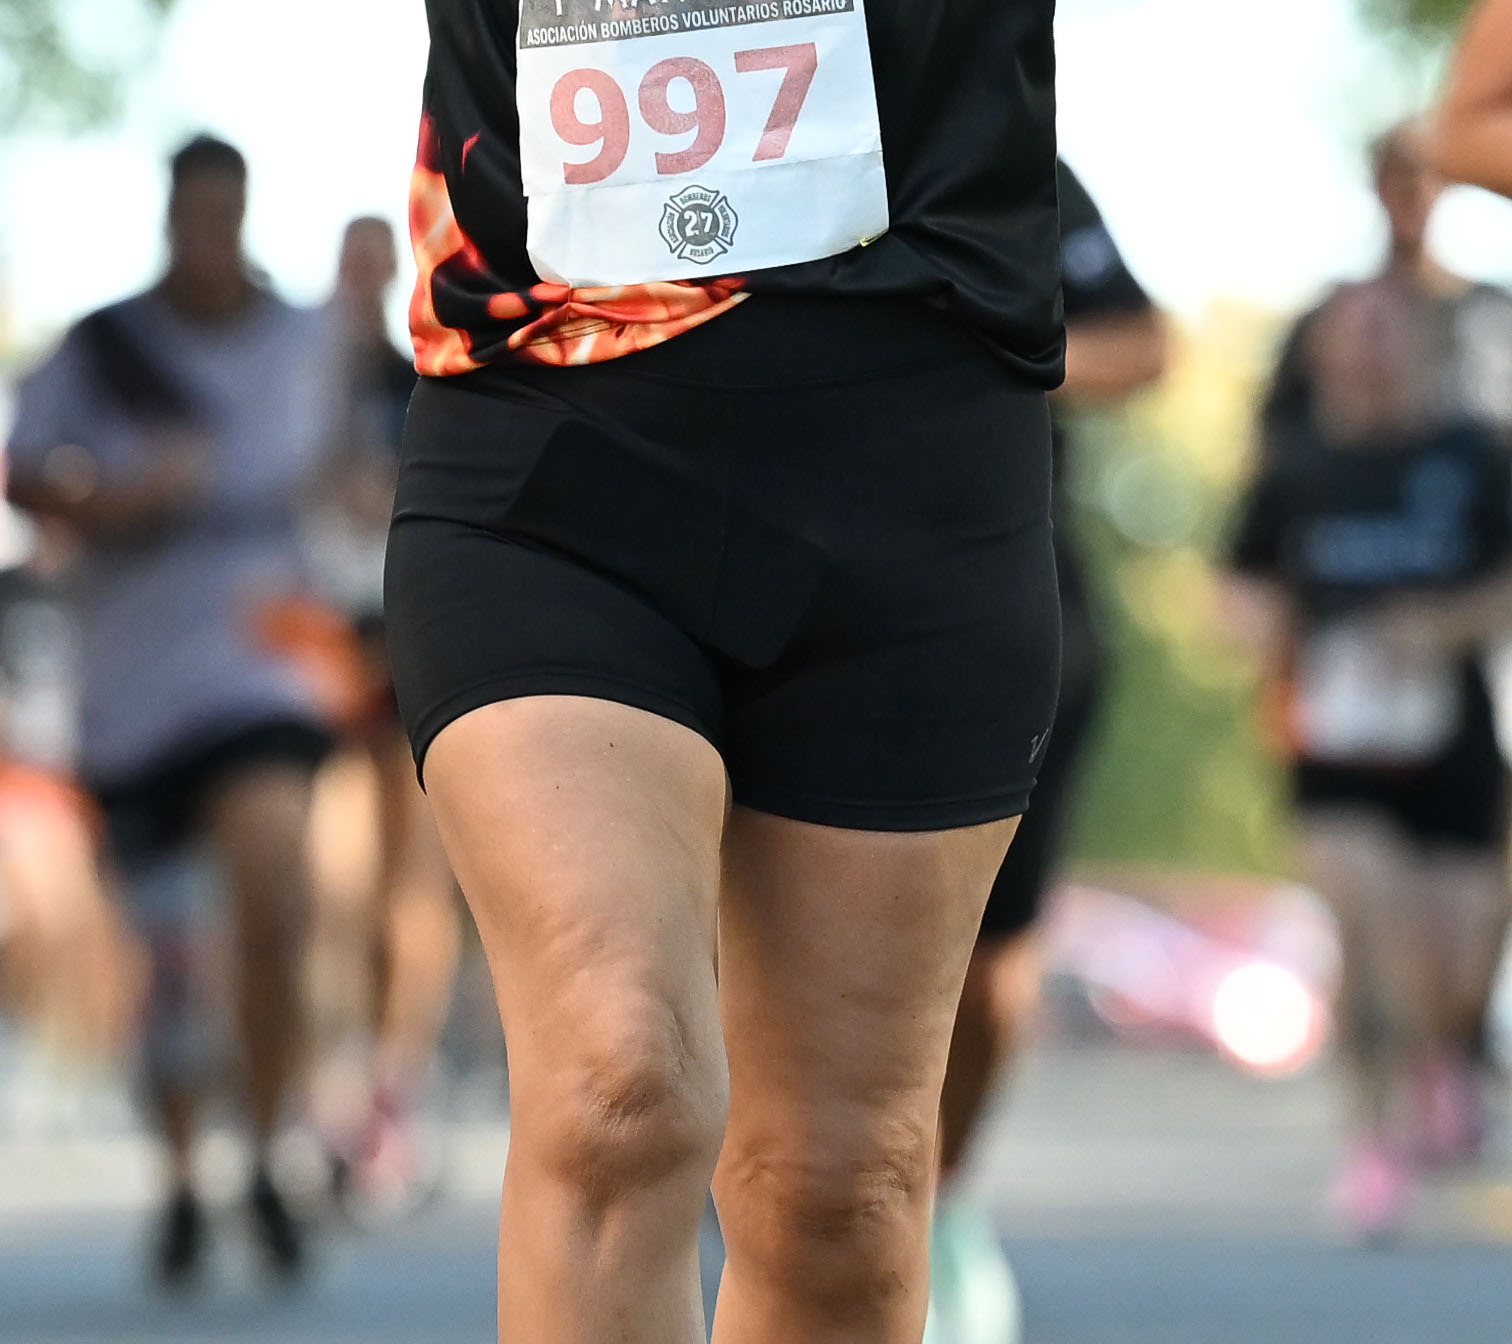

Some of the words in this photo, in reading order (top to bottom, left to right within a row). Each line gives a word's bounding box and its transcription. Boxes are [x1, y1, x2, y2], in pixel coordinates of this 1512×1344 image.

[526, 19, 597, 46] ASOCIACIÓN
[600, 13, 680, 39] BOMBEROS
[682, 1, 779, 28] VOLUNTARIOS
[549, 41, 819, 185] 997
[683, 210, 714, 237] 27
